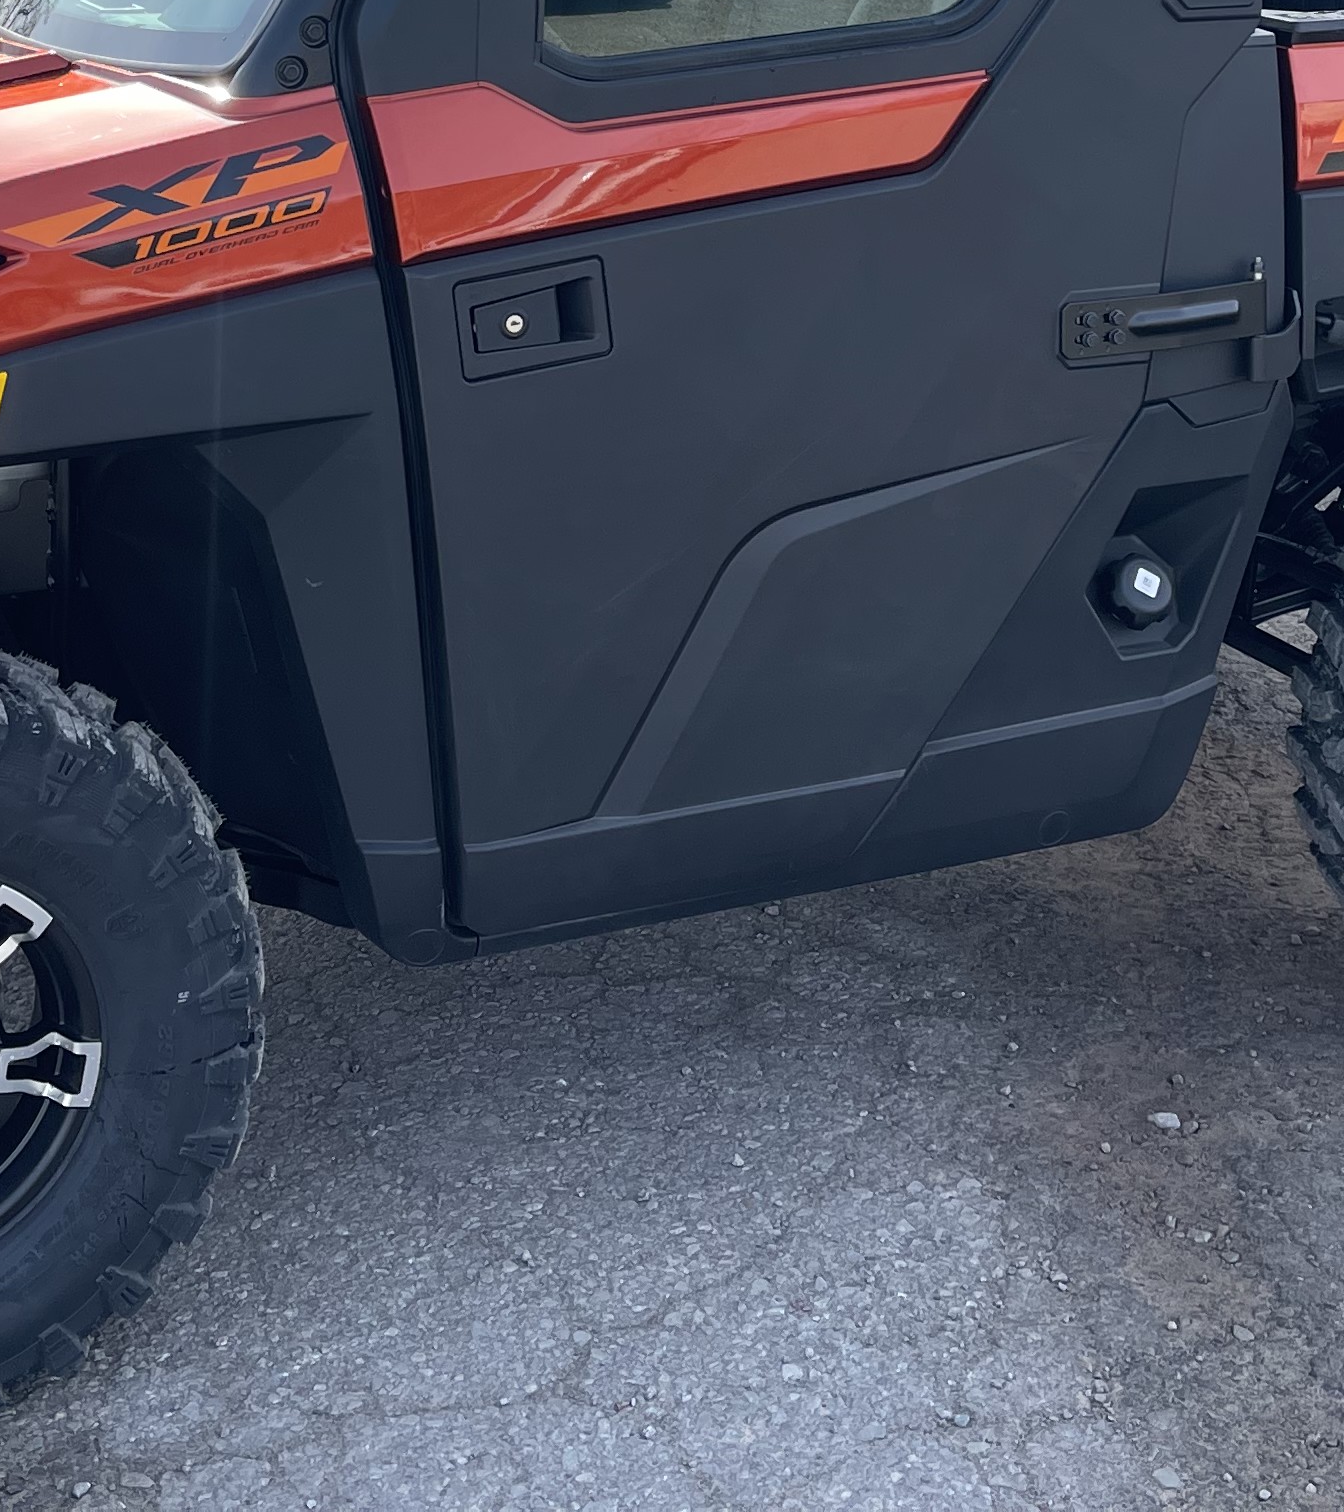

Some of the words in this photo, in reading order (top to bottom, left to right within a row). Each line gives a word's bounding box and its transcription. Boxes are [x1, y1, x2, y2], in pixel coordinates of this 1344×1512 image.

[58, 134, 337, 243] XP
[133, 190, 328, 261] 1000
[133, 257, 181, 275] DUAL
[185, 230, 279, 261] OVERHEAD
[282, 219, 321, 236] CAM
